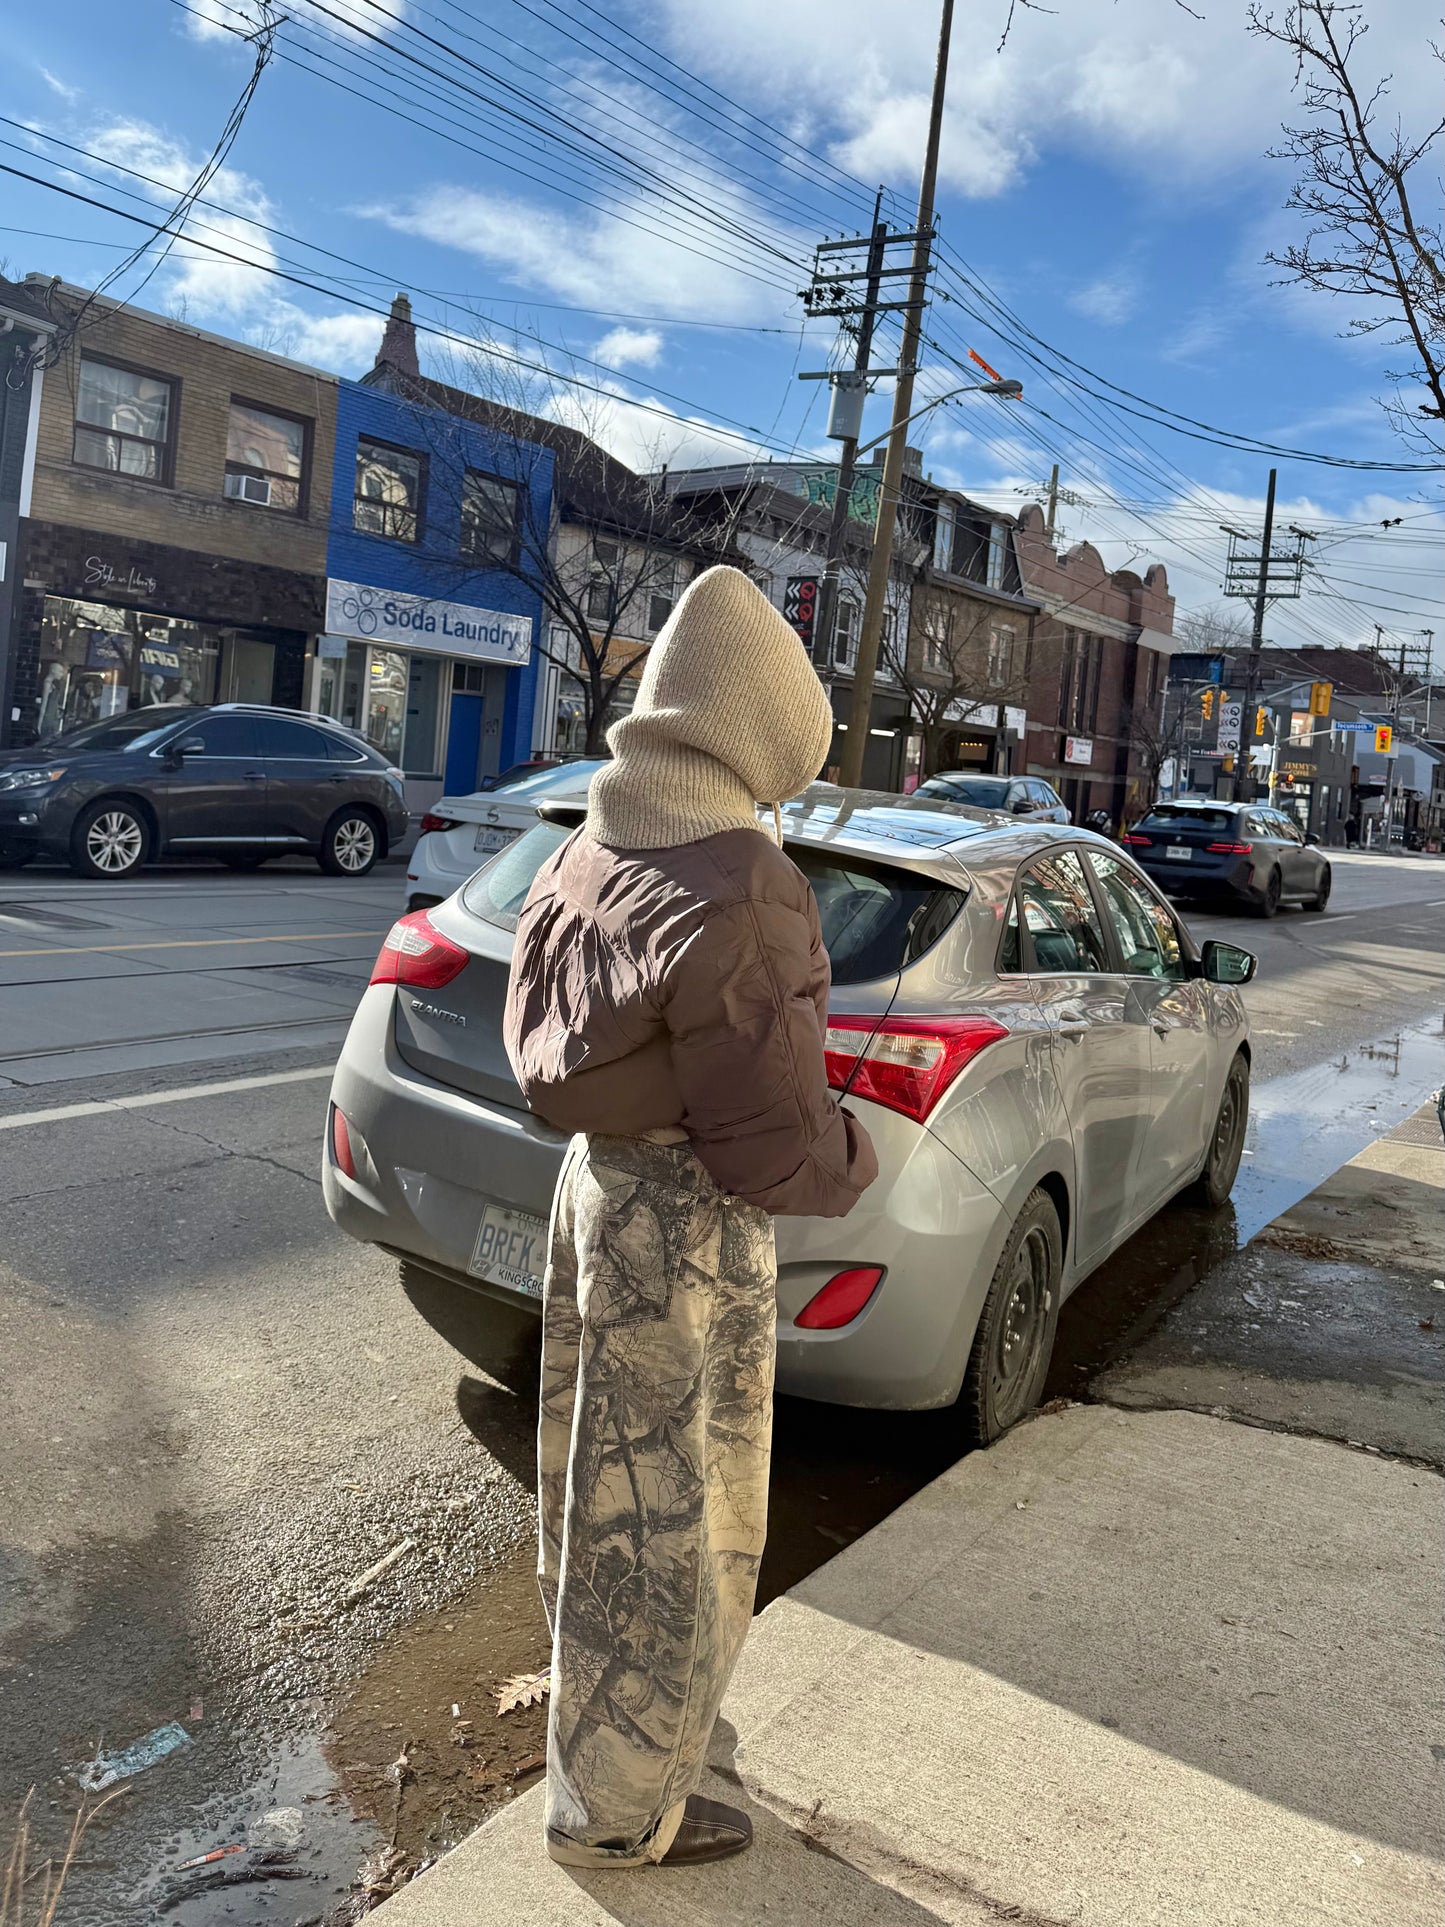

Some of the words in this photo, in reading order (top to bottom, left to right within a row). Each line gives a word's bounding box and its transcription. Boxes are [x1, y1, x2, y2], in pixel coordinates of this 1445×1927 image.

[383, 602, 436, 633] Soda
[442, 614, 519, 651] Laundry
[1284, 761, 1317, 771] JIMMY'S
[411, 999, 466, 1027] ELANTRA
[479, 1223, 536, 1272] BRFK
